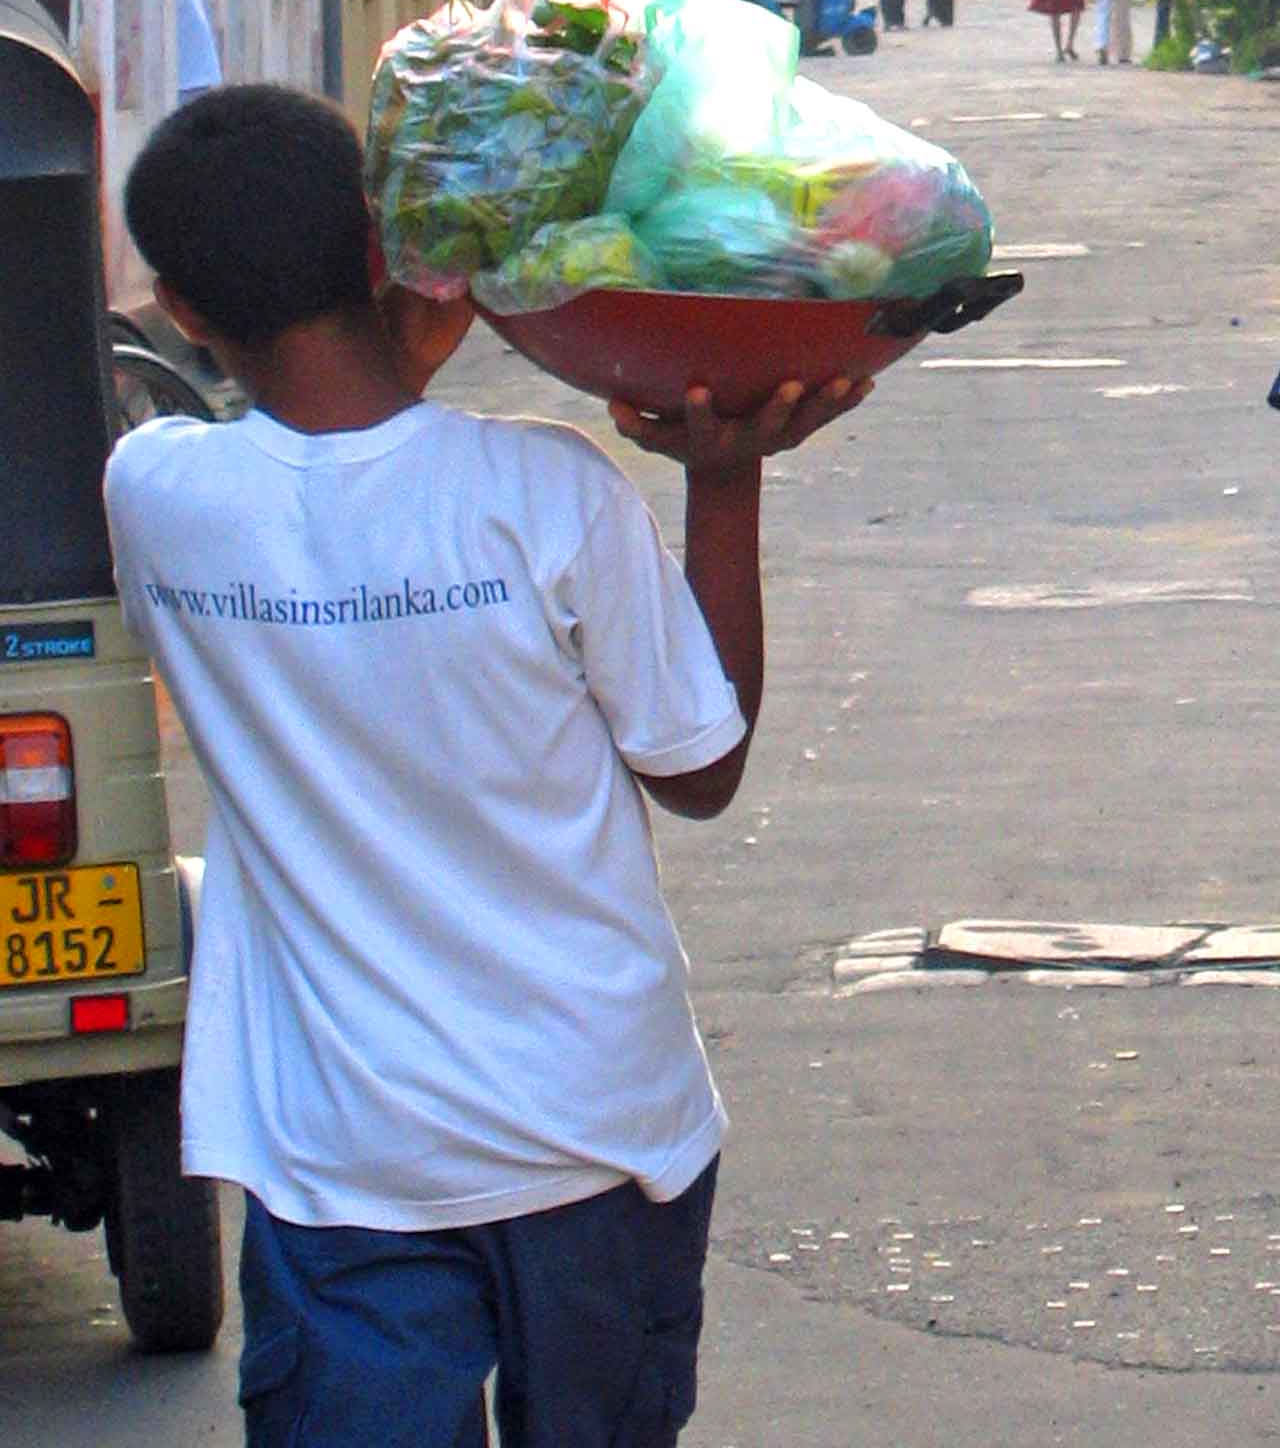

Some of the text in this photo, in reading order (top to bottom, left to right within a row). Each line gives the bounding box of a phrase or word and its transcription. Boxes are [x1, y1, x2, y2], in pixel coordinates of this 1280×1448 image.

[145, 578, 510, 625] www.villasinsrilanka.com
[5, 632, 91, 657] 2 STROKE
[7, 926, 117, 977] 8152
